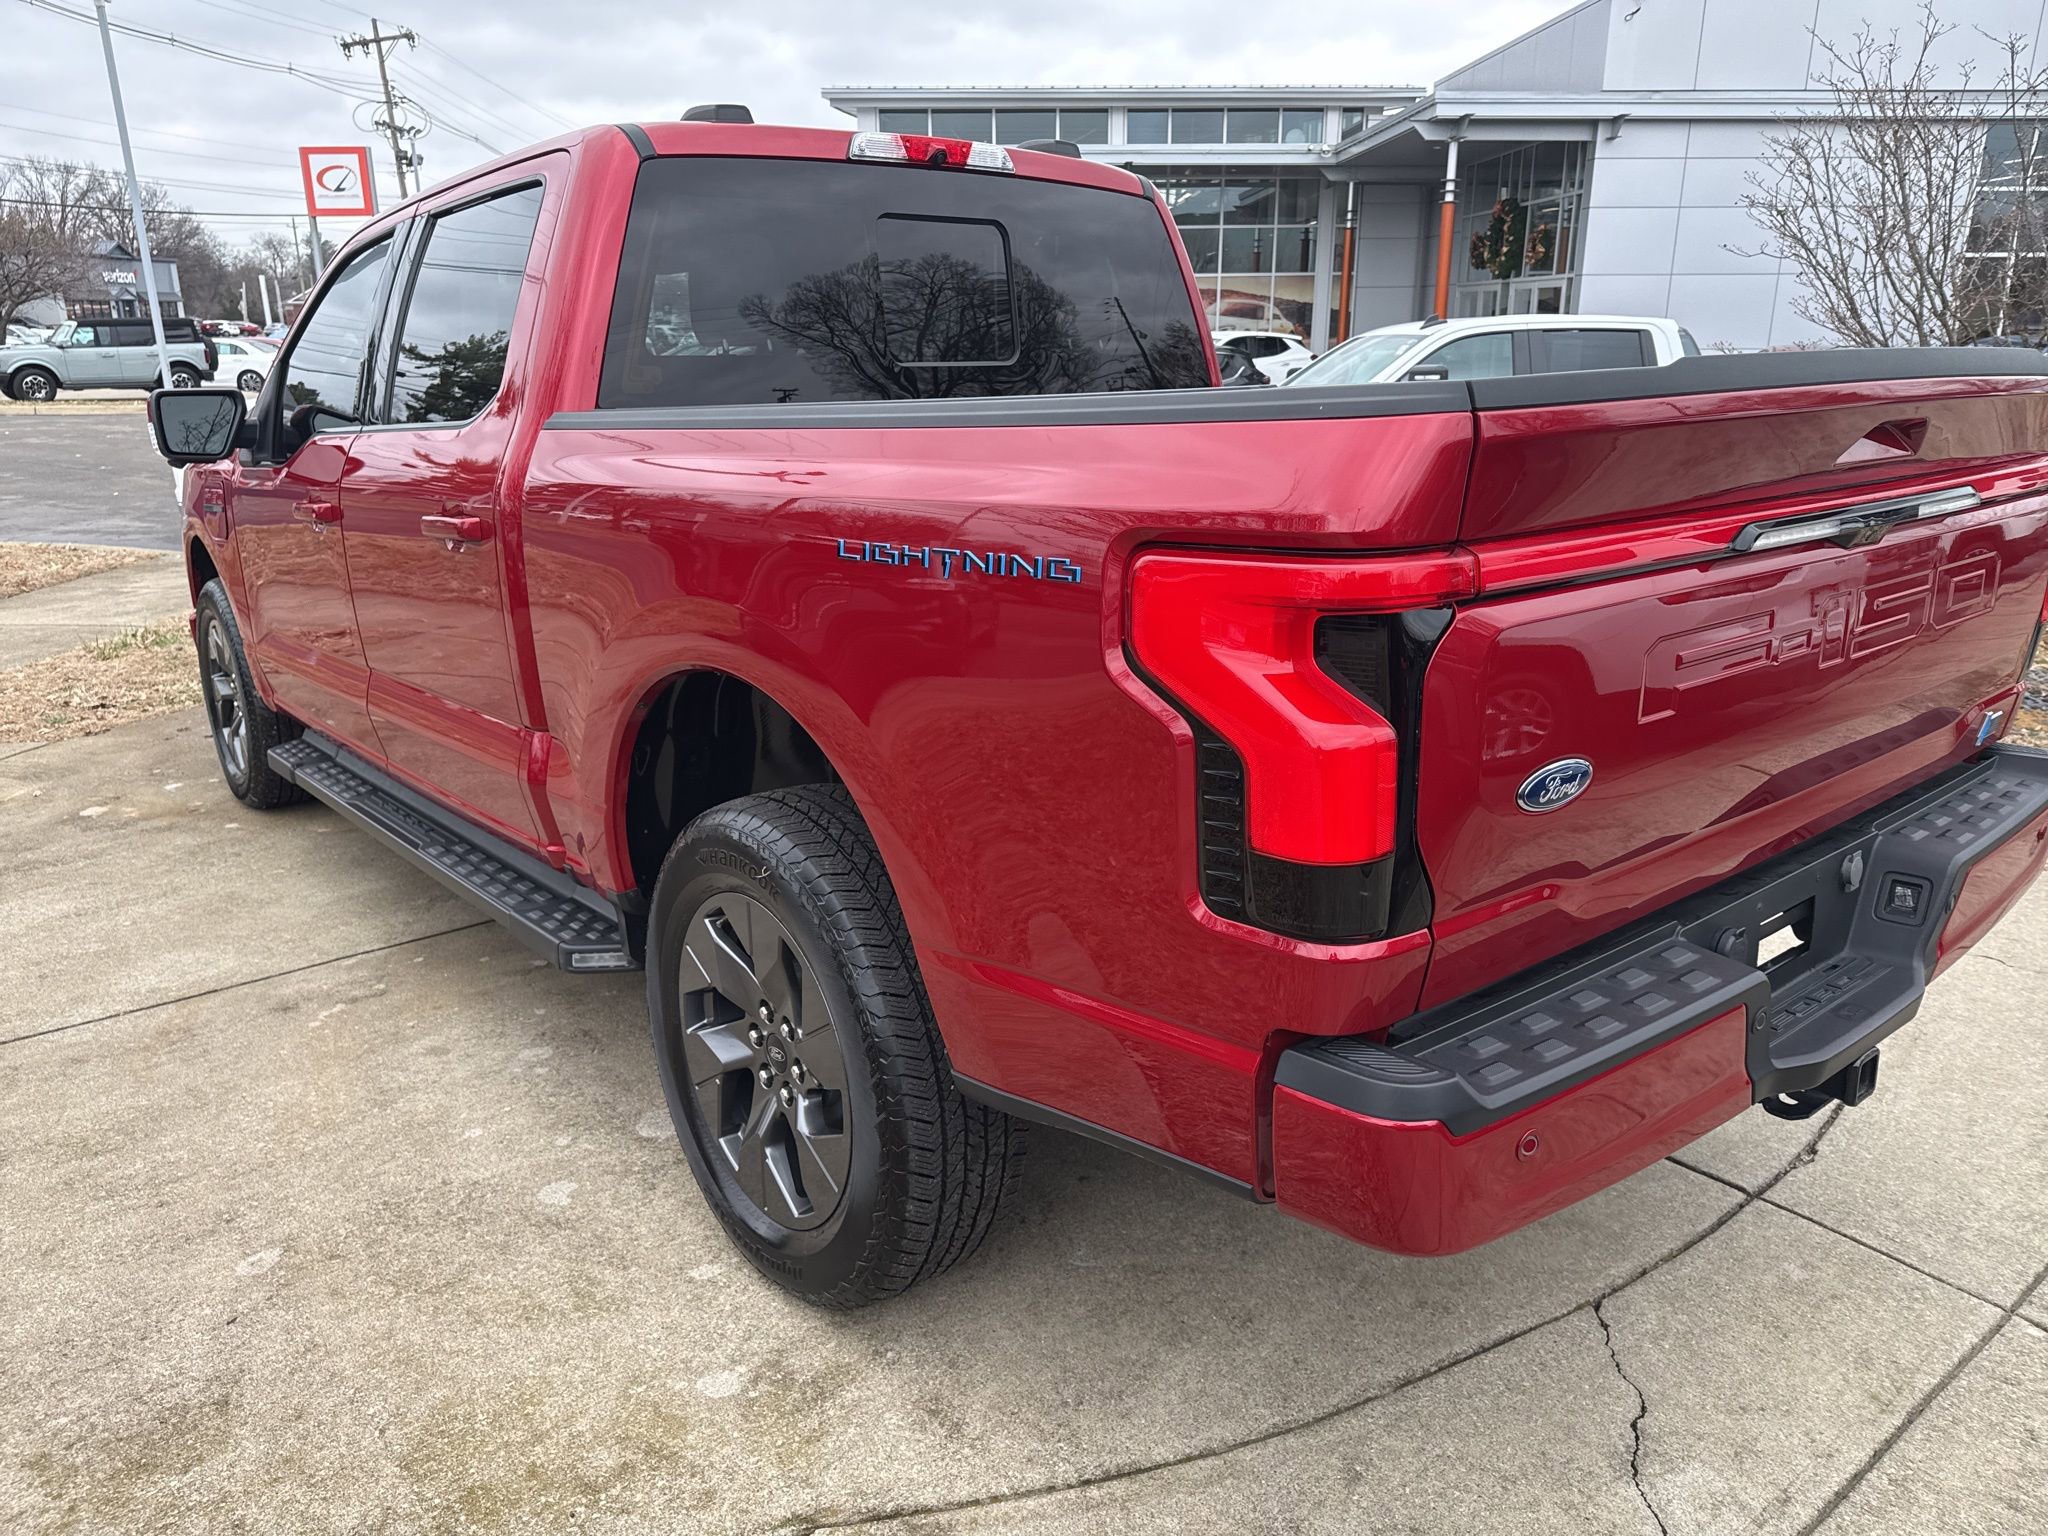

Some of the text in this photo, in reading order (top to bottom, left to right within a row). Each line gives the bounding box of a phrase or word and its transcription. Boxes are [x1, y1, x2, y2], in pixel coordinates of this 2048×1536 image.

[102, 268, 136, 284] verizon
[837, 538, 1082, 583] LIGHTNING
[1637, 550, 2001, 725] F-150
[1540, 770, 1582, 803] Ford
